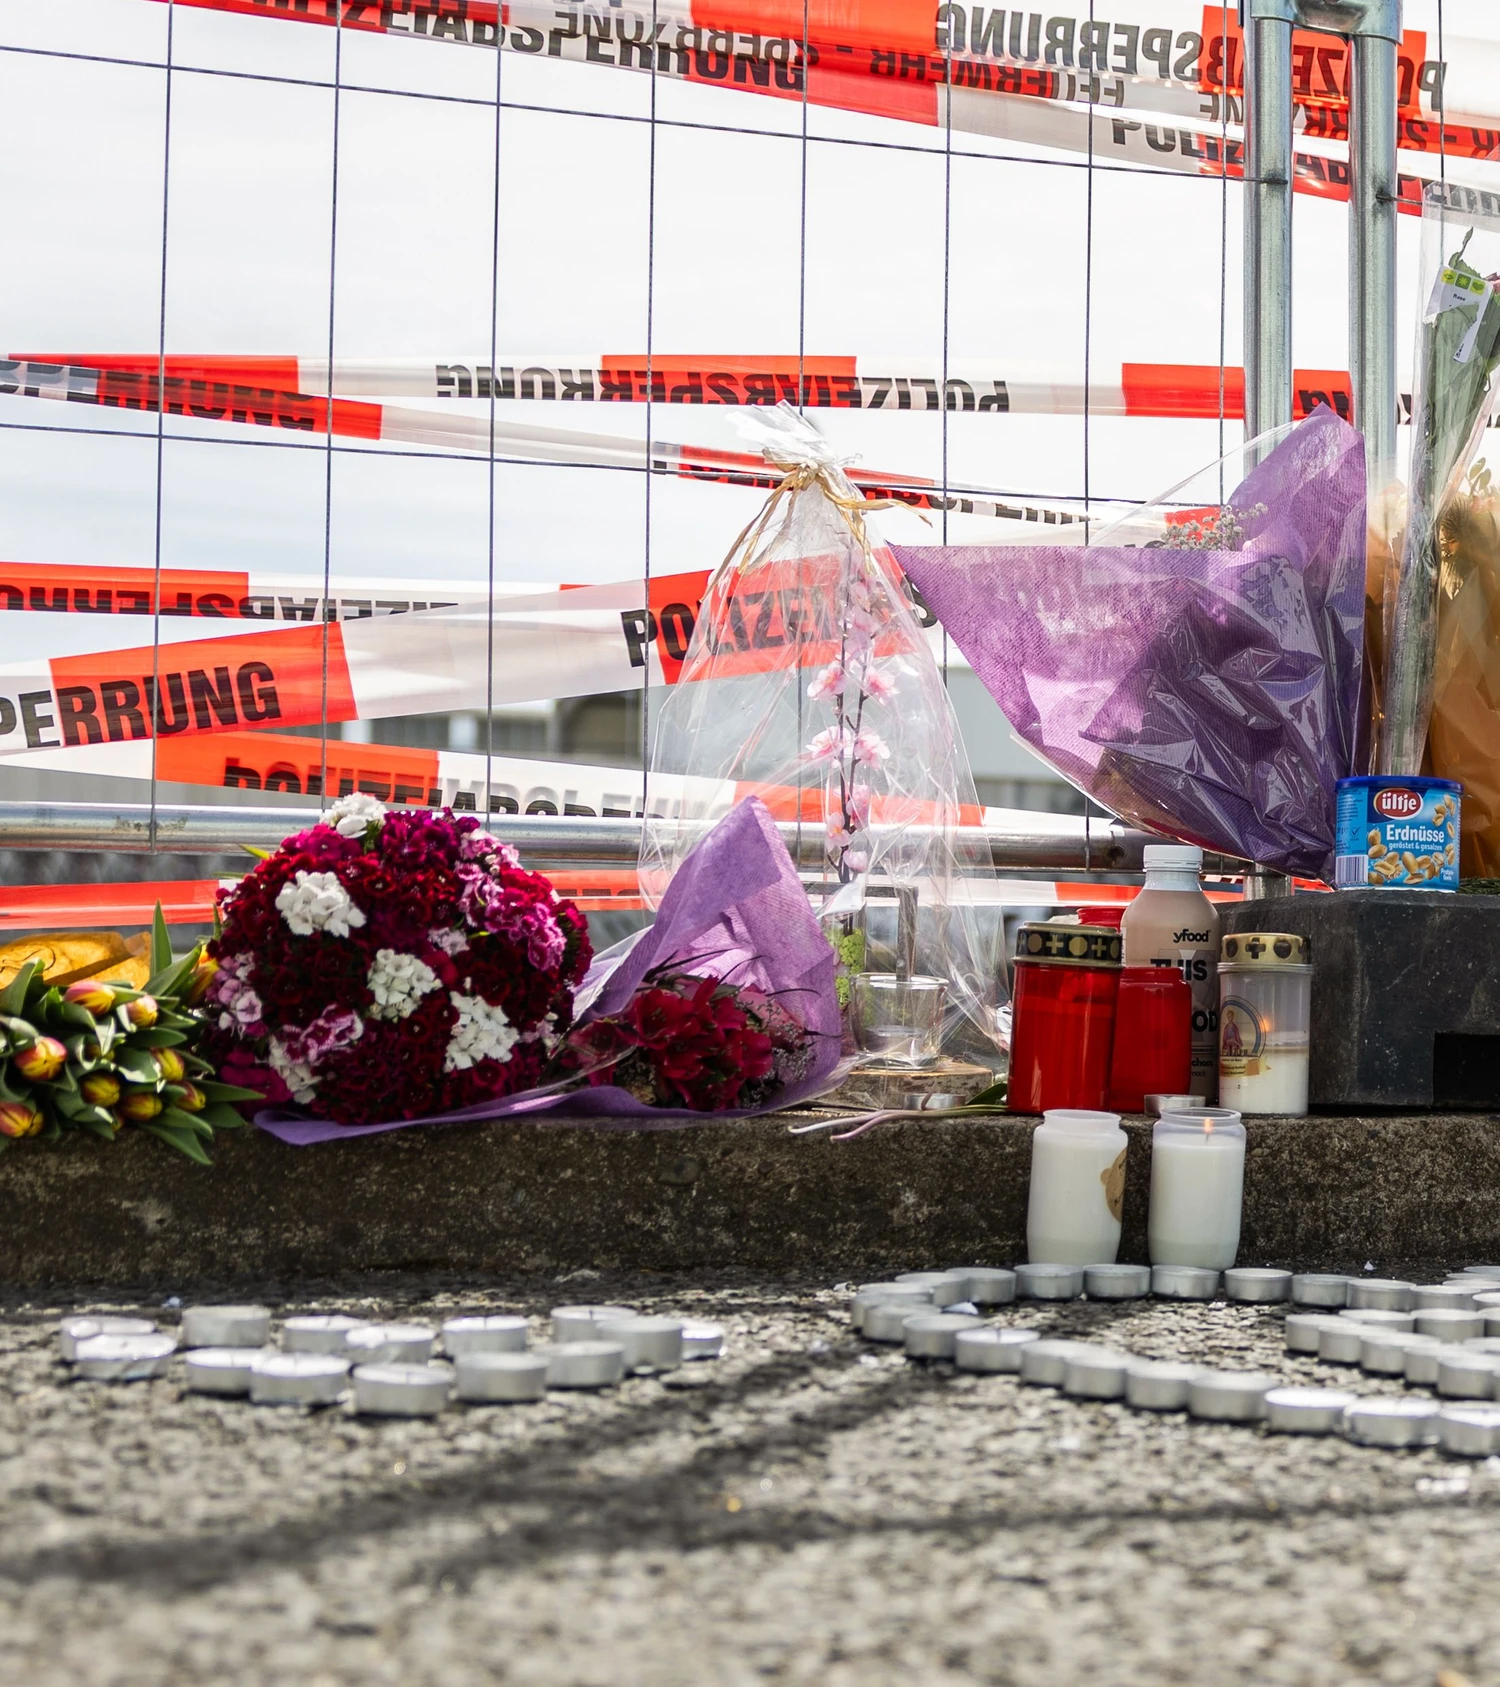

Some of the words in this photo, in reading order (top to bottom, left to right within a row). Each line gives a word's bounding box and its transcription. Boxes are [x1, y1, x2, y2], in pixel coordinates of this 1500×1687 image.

[1382, 792, 1417, 813] ültje
[1386, 824, 1444, 843] Erdnüsse
[1388, 841, 1415, 851] geröstet
[1415, 842, 1420, 850] &
[1173, 928, 1210, 944] yfood
